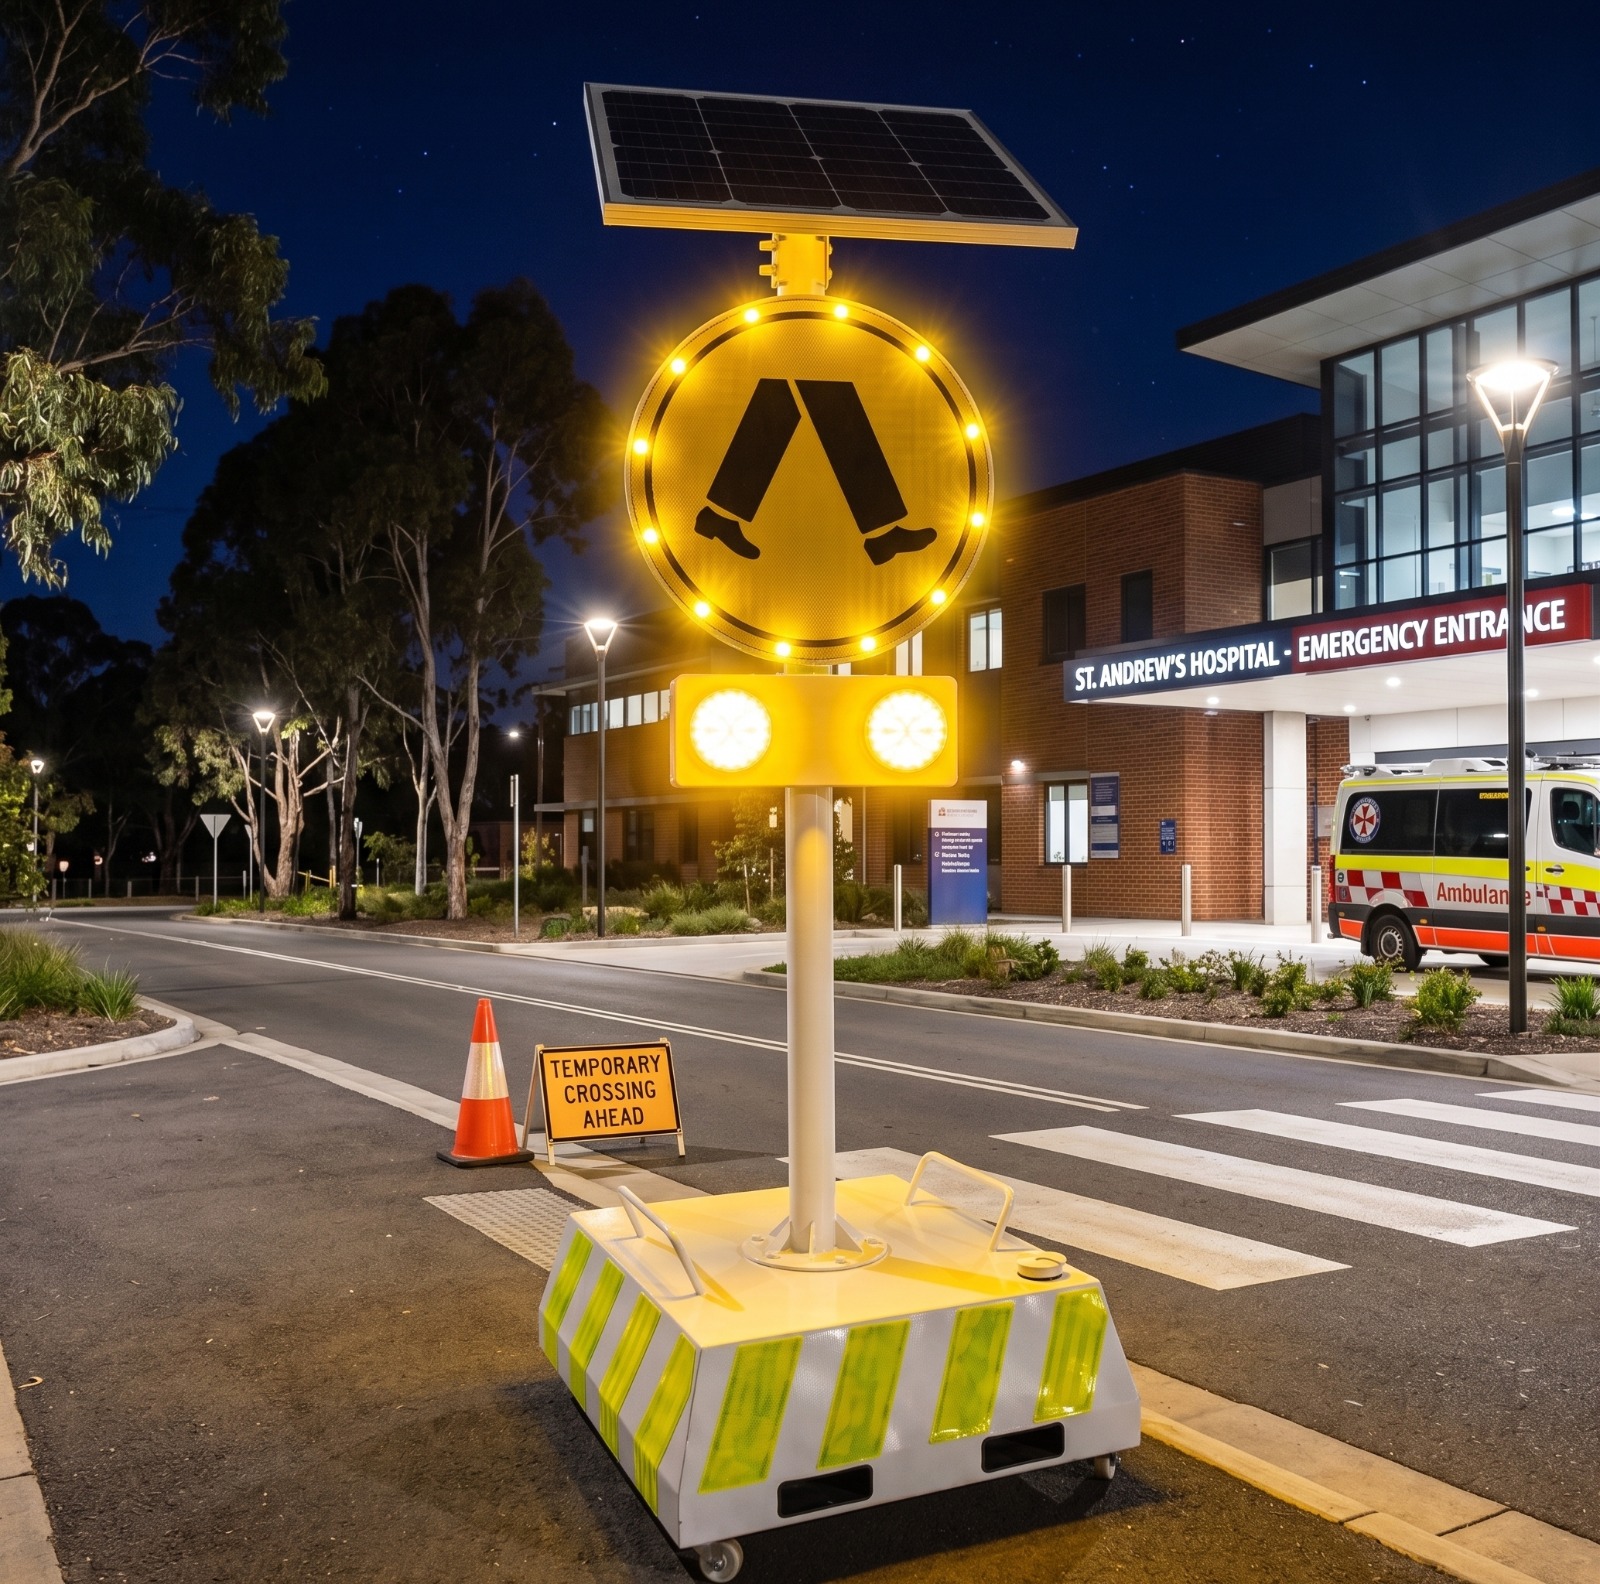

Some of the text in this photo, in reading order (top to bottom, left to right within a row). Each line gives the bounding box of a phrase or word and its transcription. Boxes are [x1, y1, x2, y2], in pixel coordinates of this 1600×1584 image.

[1075, 666, 1097, 691] ST.
[1099, 653, 1186, 688] ANDREW'S
[1190, 641, 1280, 677] HOSPITAL
[1298, 619, 1428, 662] EMERGENCY
[1436, 882, 1531, 906] Ambulane
[550, 1054, 660, 1078] TEMPORARY
[564, 1080, 656, 1104] CROSSING
[583, 1106, 644, 1129] AHEAD
